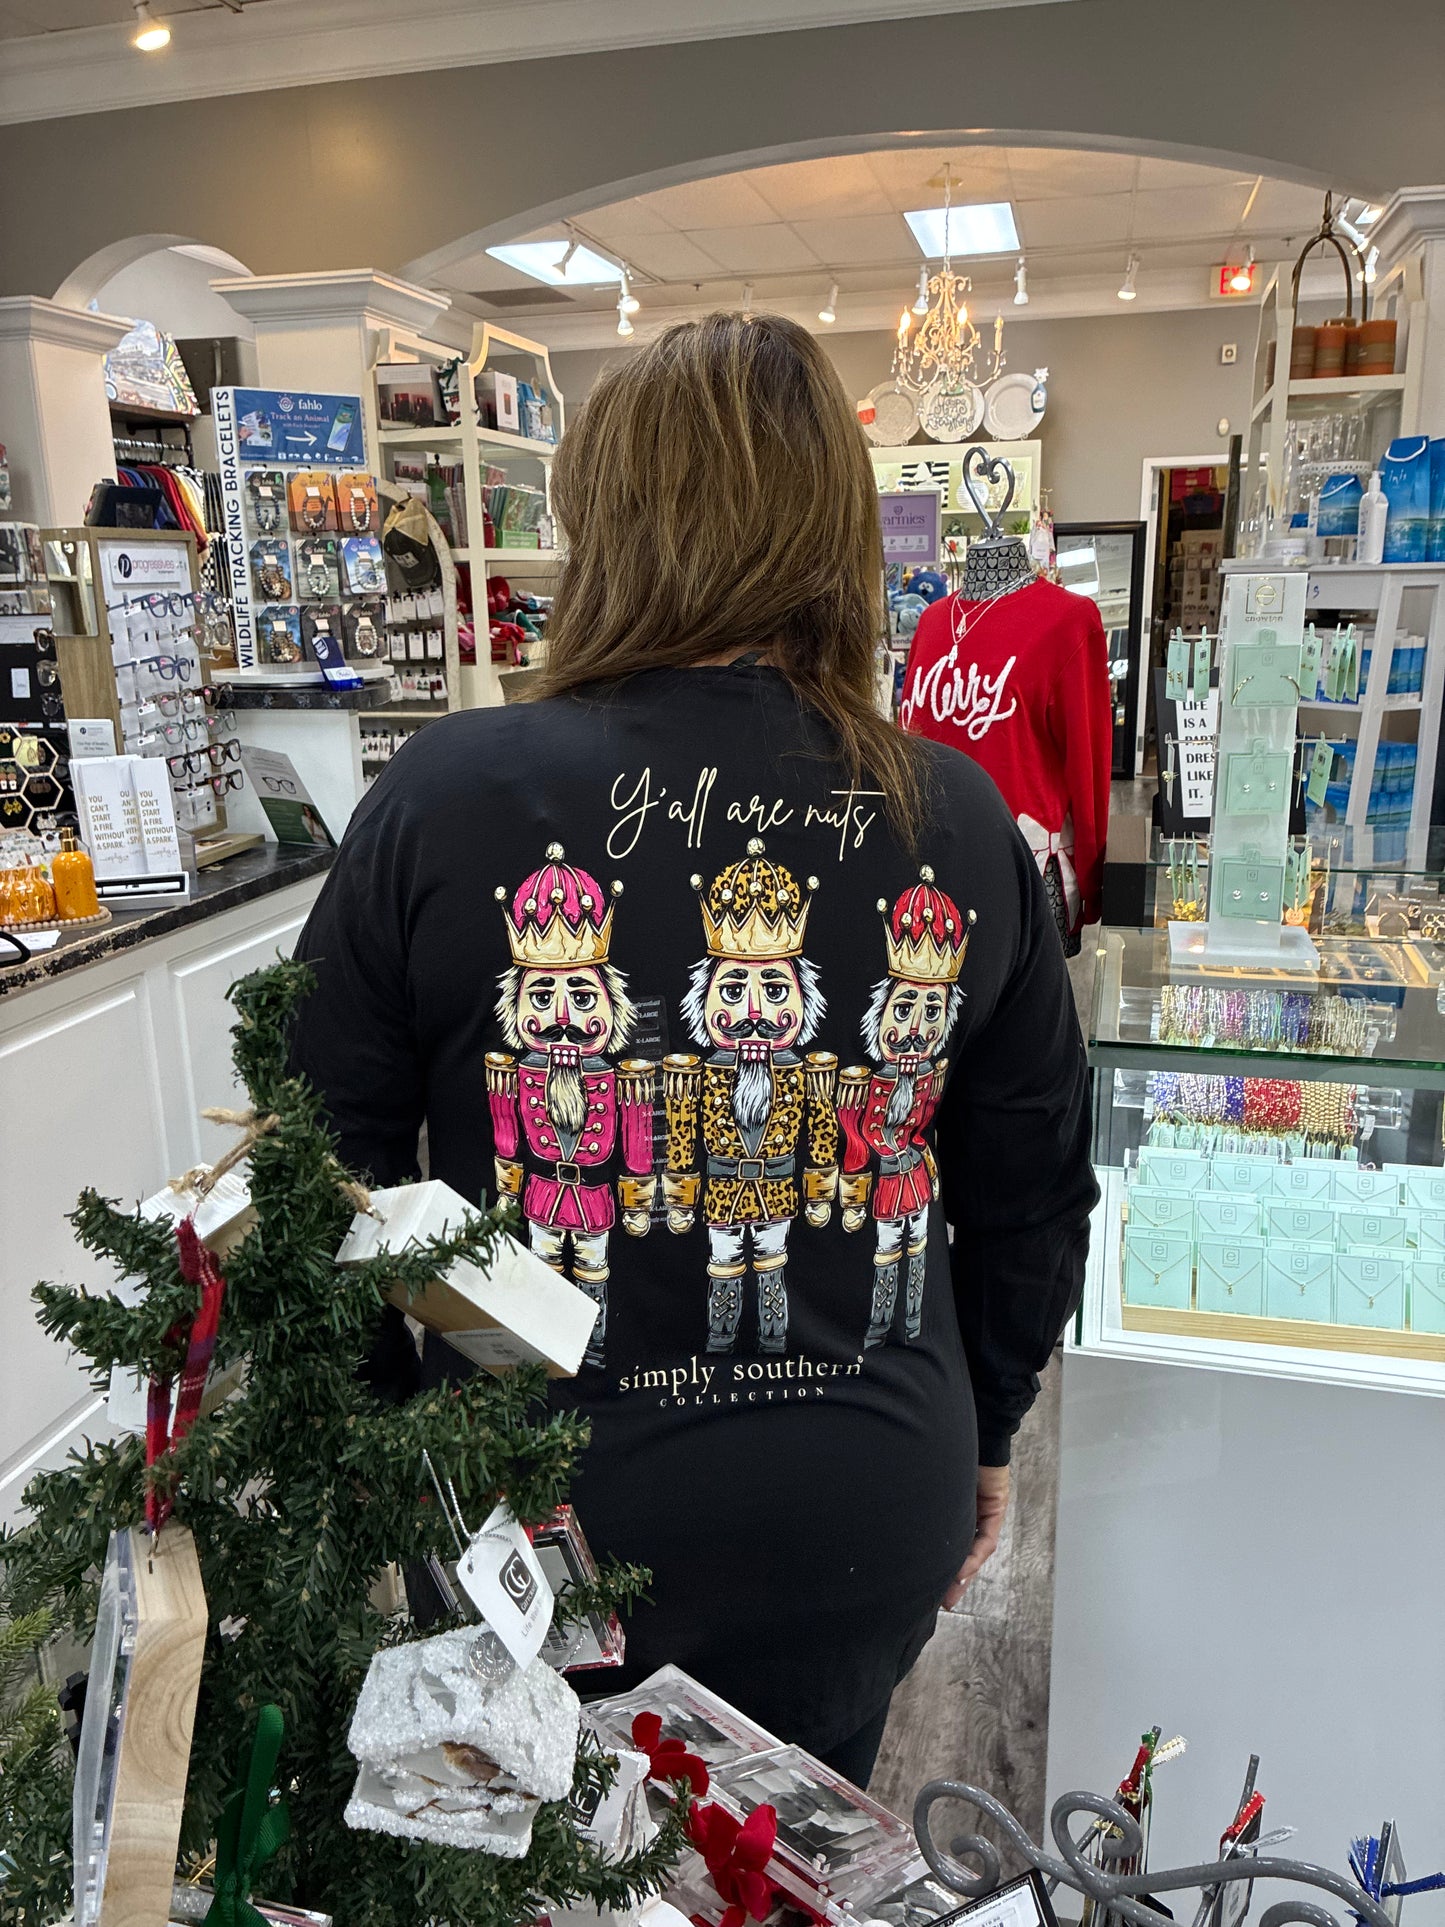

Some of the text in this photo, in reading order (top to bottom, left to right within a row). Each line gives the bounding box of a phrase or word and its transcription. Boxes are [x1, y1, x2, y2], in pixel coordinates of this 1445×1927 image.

[298, 398, 323, 411] fahlo
[271, 412, 291, 421] Track
[304, 414, 330, 423] Animal
[882, 513, 926, 525] armies
[216, 391, 254, 669] WILDLIFE TRACKING BRACELETS
[901, 655, 1017, 741] Merry
[1182, 701, 1208, 711] LIFE
[1183, 718, 1207, 729] IS A
[1185, 736, 1214, 746] PART
[1186, 753, 1215, 763] DRES
[1187, 771, 1213, 781] LIKE
[120, 790, 130, 798] OU
[139, 790, 153, 798] YOU
[1188, 789, 1204, 799] IT.
[140, 799, 159, 807] CAN'T
[90, 804, 108, 813] CAN'T
[92, 814, 111, 822] START
[606, 767, 886, 861] Y'all are nuts
[100, 823, 113, 831] FIRE
[145, 826, 174, 835] WITHOUT
[95, 831, 125, 840] WITHOUT
[618, 1354, 862, 1396] simply southern
[659, 1386, 825, 1408] COLLECTION
[1000, 1879, 1029, 1897] Proudly
[977, 1895, 999, 1908] made
